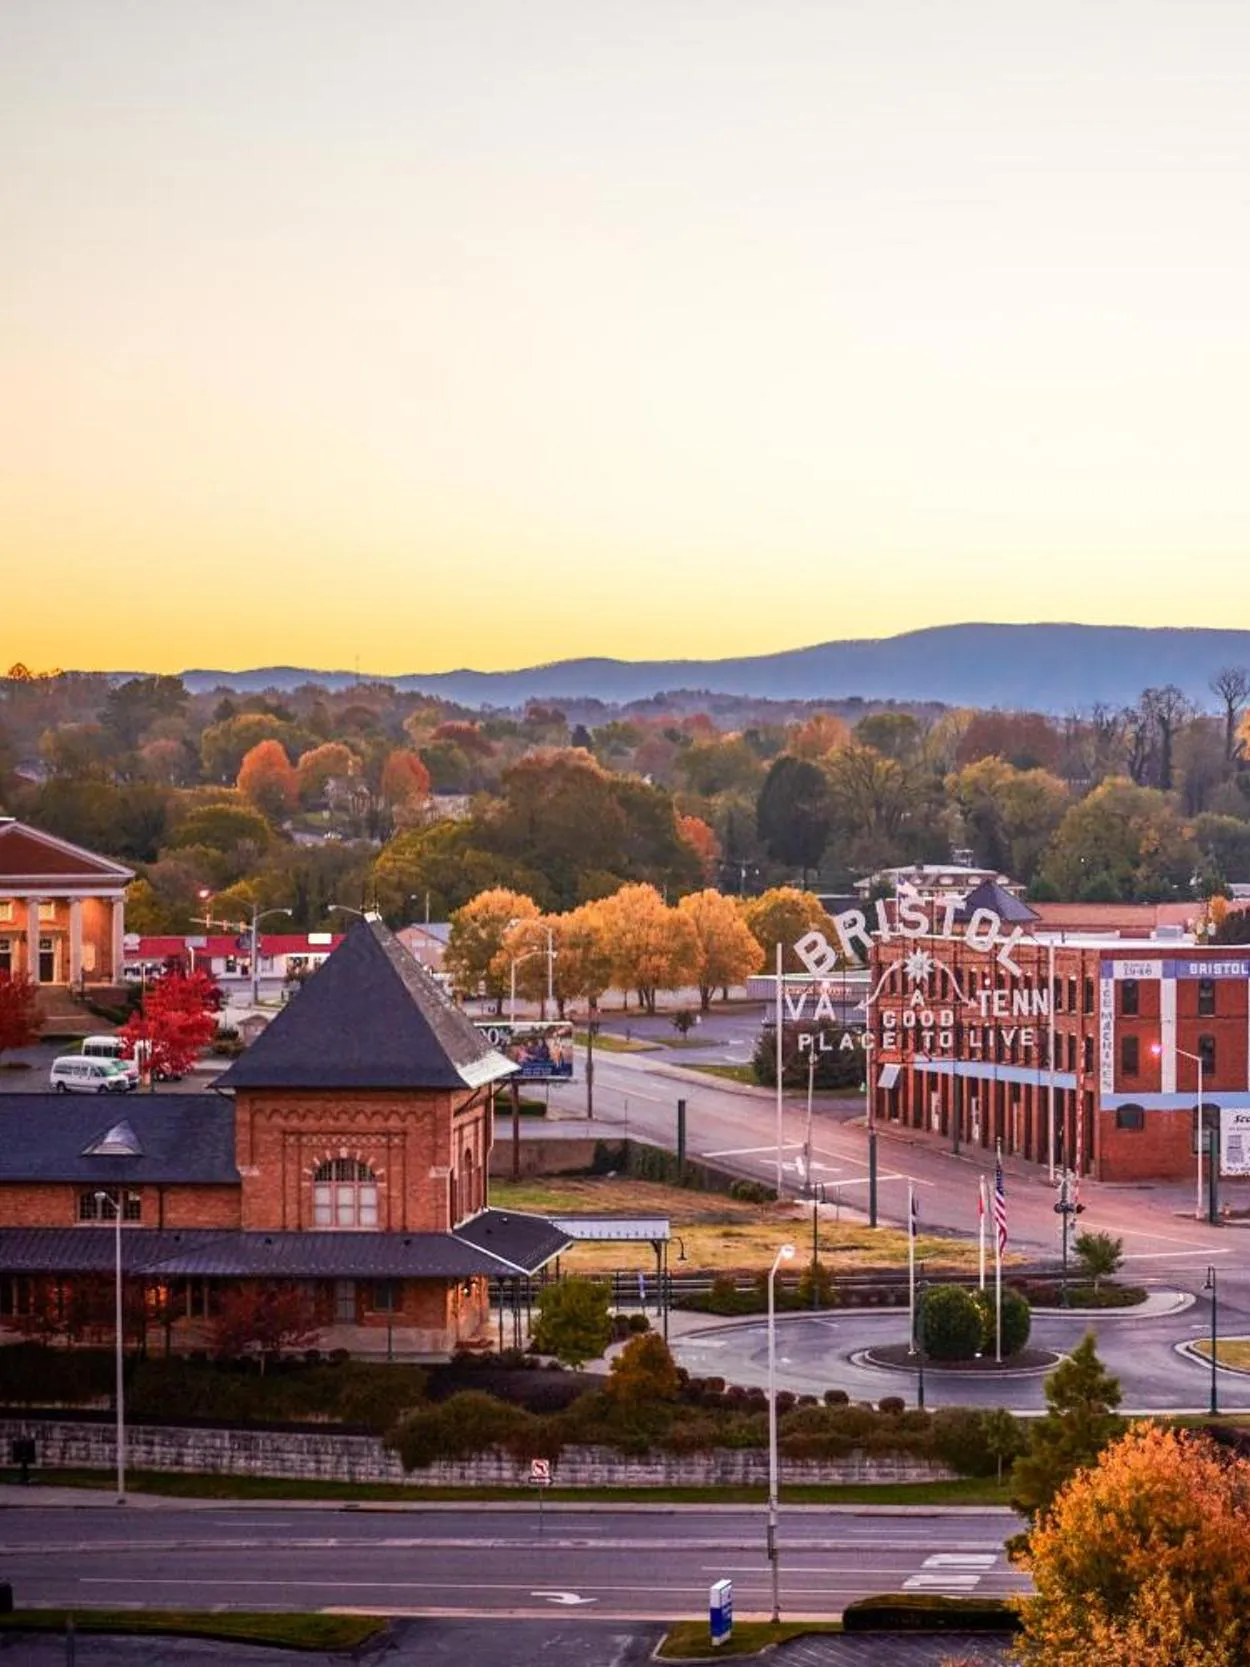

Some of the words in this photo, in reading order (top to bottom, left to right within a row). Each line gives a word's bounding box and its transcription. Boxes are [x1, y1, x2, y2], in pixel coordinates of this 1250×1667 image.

[793, 899, 1024, 978] BRISTOL
[1189, 962, 1249, 975] BRISTOL
[785, 988, 837, 1021] VA
[976, 988, 1050, 1018] TENN
[911, 989, 925, 1006] A
[882, 1010, 955, 1028] GOOD
[798, 1031, 897, 1052] PLACE
[921, 1031, 953, 1049] TO
[968, 1027, 1035, 1048] LIVE
